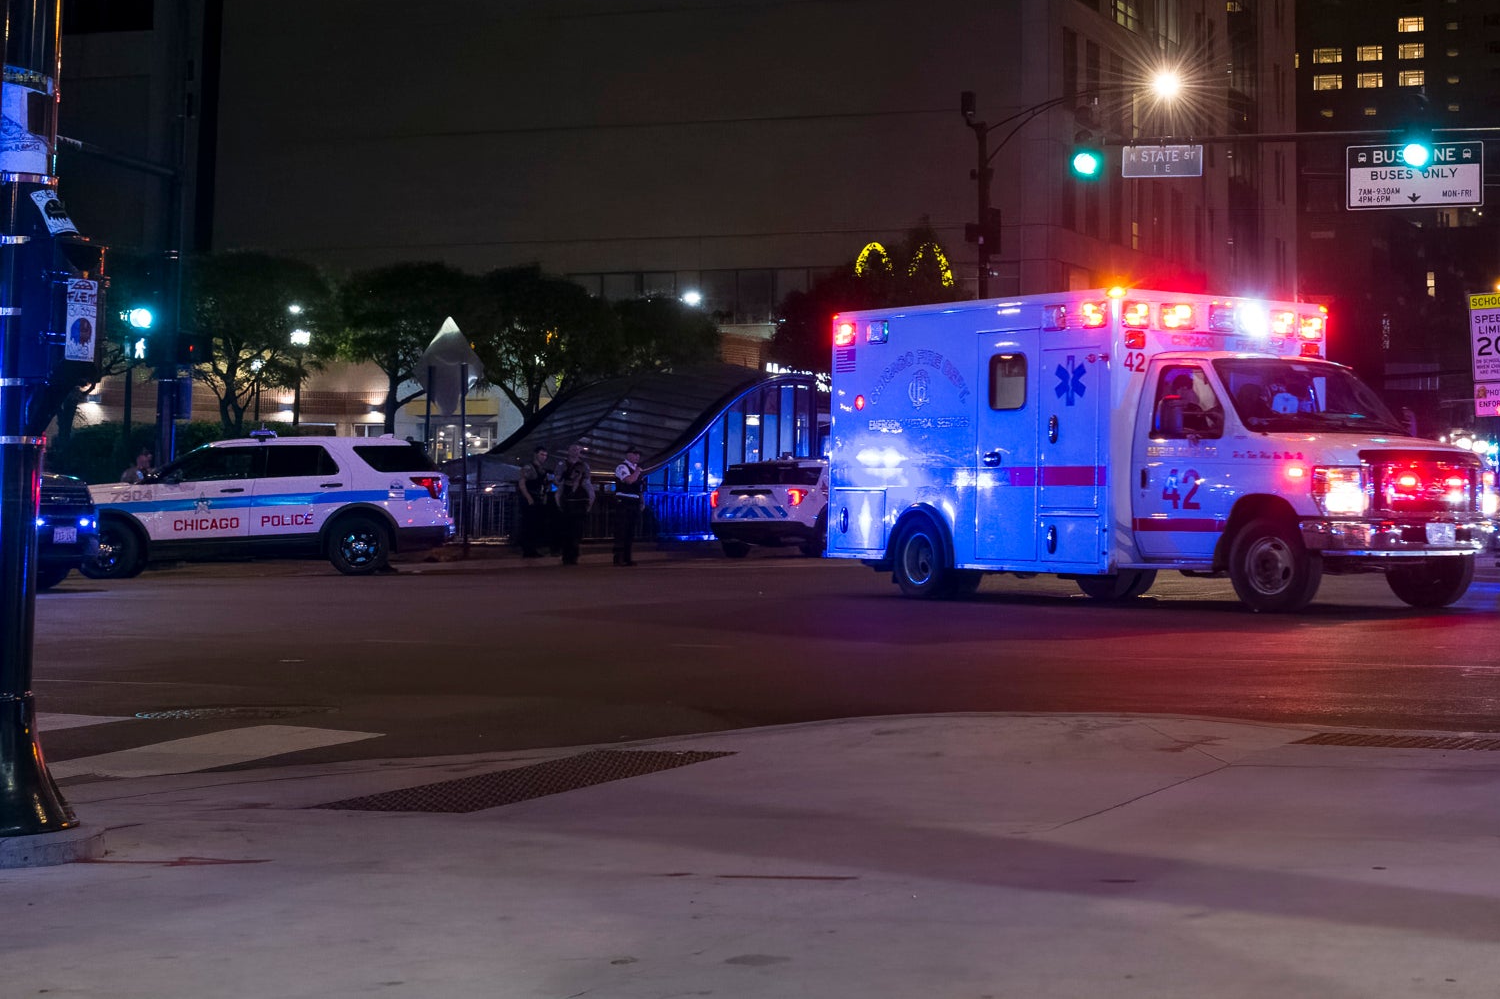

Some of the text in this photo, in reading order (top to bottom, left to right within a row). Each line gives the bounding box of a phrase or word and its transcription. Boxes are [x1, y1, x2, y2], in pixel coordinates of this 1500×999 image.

[1129, 150, 1196, 162] N STATE ST
[1165, 164, 1171, 172] E
[1371, 167, 1458, 180] BUSES ONLY
[1442, 189, 1472, 198] MON-FRI
[1123, 351, 1146, 373] 42
[1162, 468, 1202, 510] 42
[110, 490, 153, 502] 7304
[173, 513, 314, 532] CHICAGO POLICE
